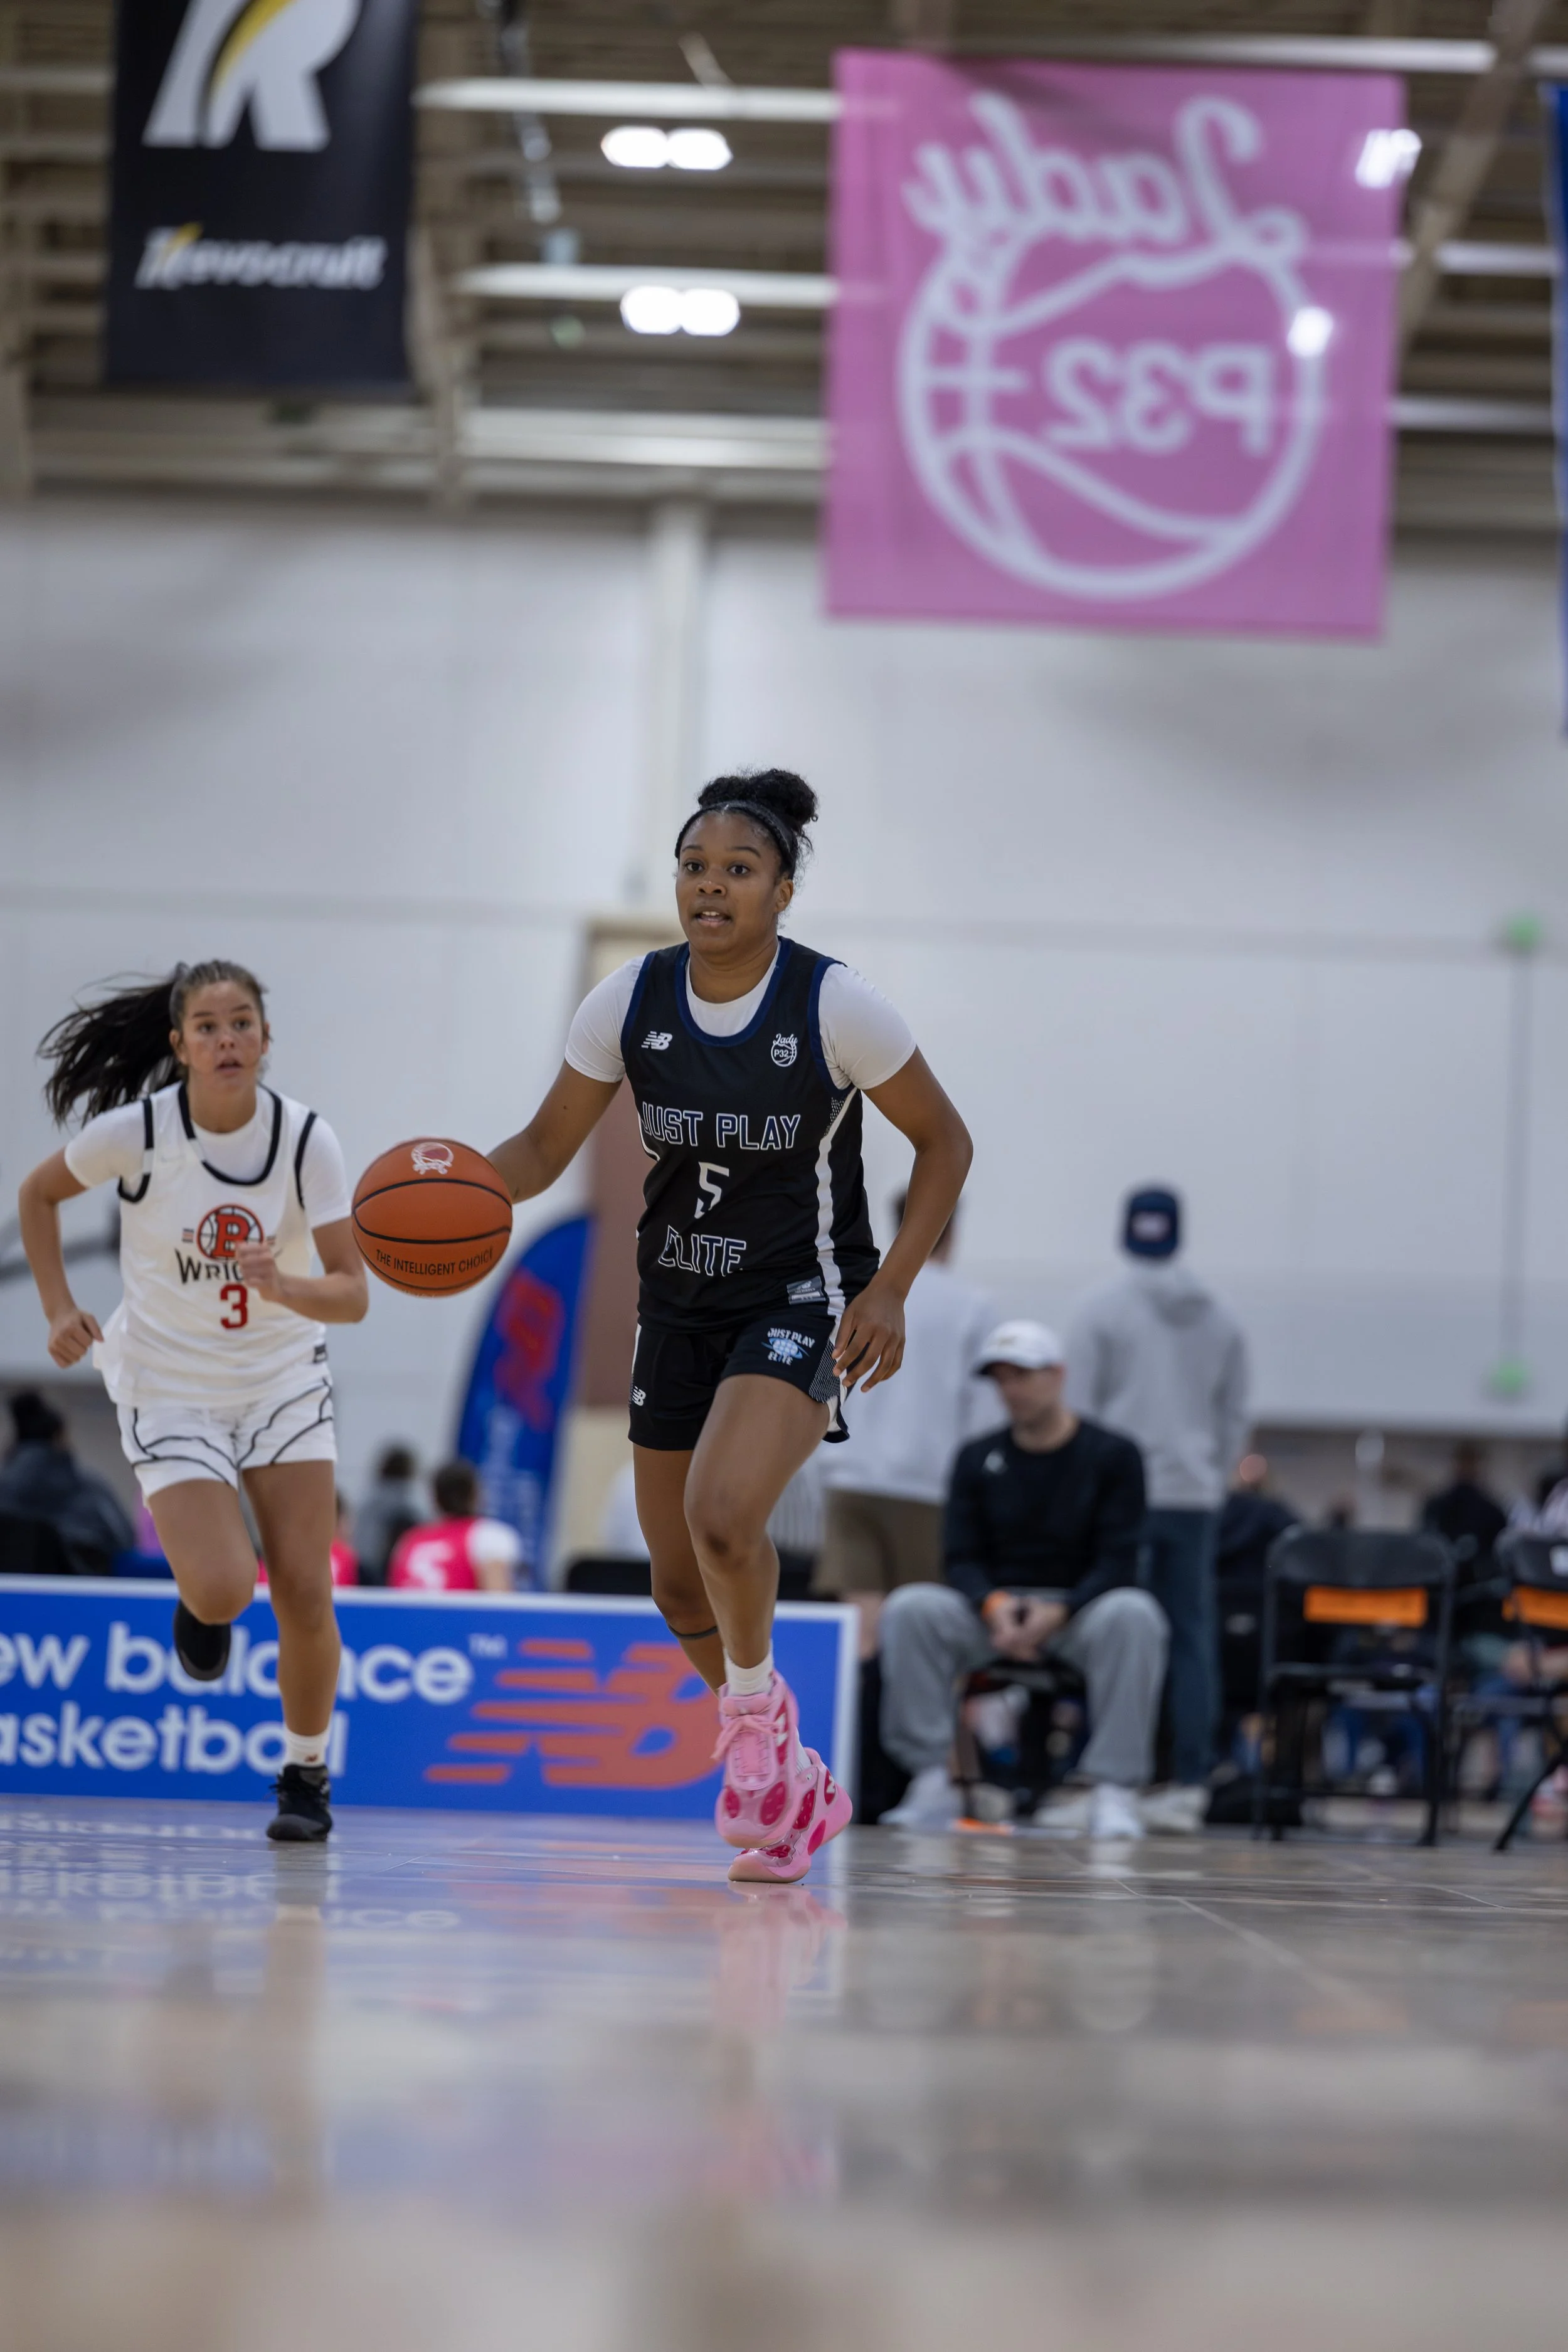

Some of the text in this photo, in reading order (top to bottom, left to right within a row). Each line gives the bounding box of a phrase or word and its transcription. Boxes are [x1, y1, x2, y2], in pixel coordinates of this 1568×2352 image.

[773, 1033, 798, 1048] Lady
[774, 1049, 789, 1057] P32
[642, 1101, 801, 1151] JUST PLAY
[694, 1162, 729, 1219] 5
[376, 1249, 391, 1267] THE
[393, 1258, 456, 1276] INTELLIGENT
[220, 1283, 248, 1330] 3
[767, 1327, 815, 1348] JUST PLAY
[104, 1620, 475, 1706] blace
